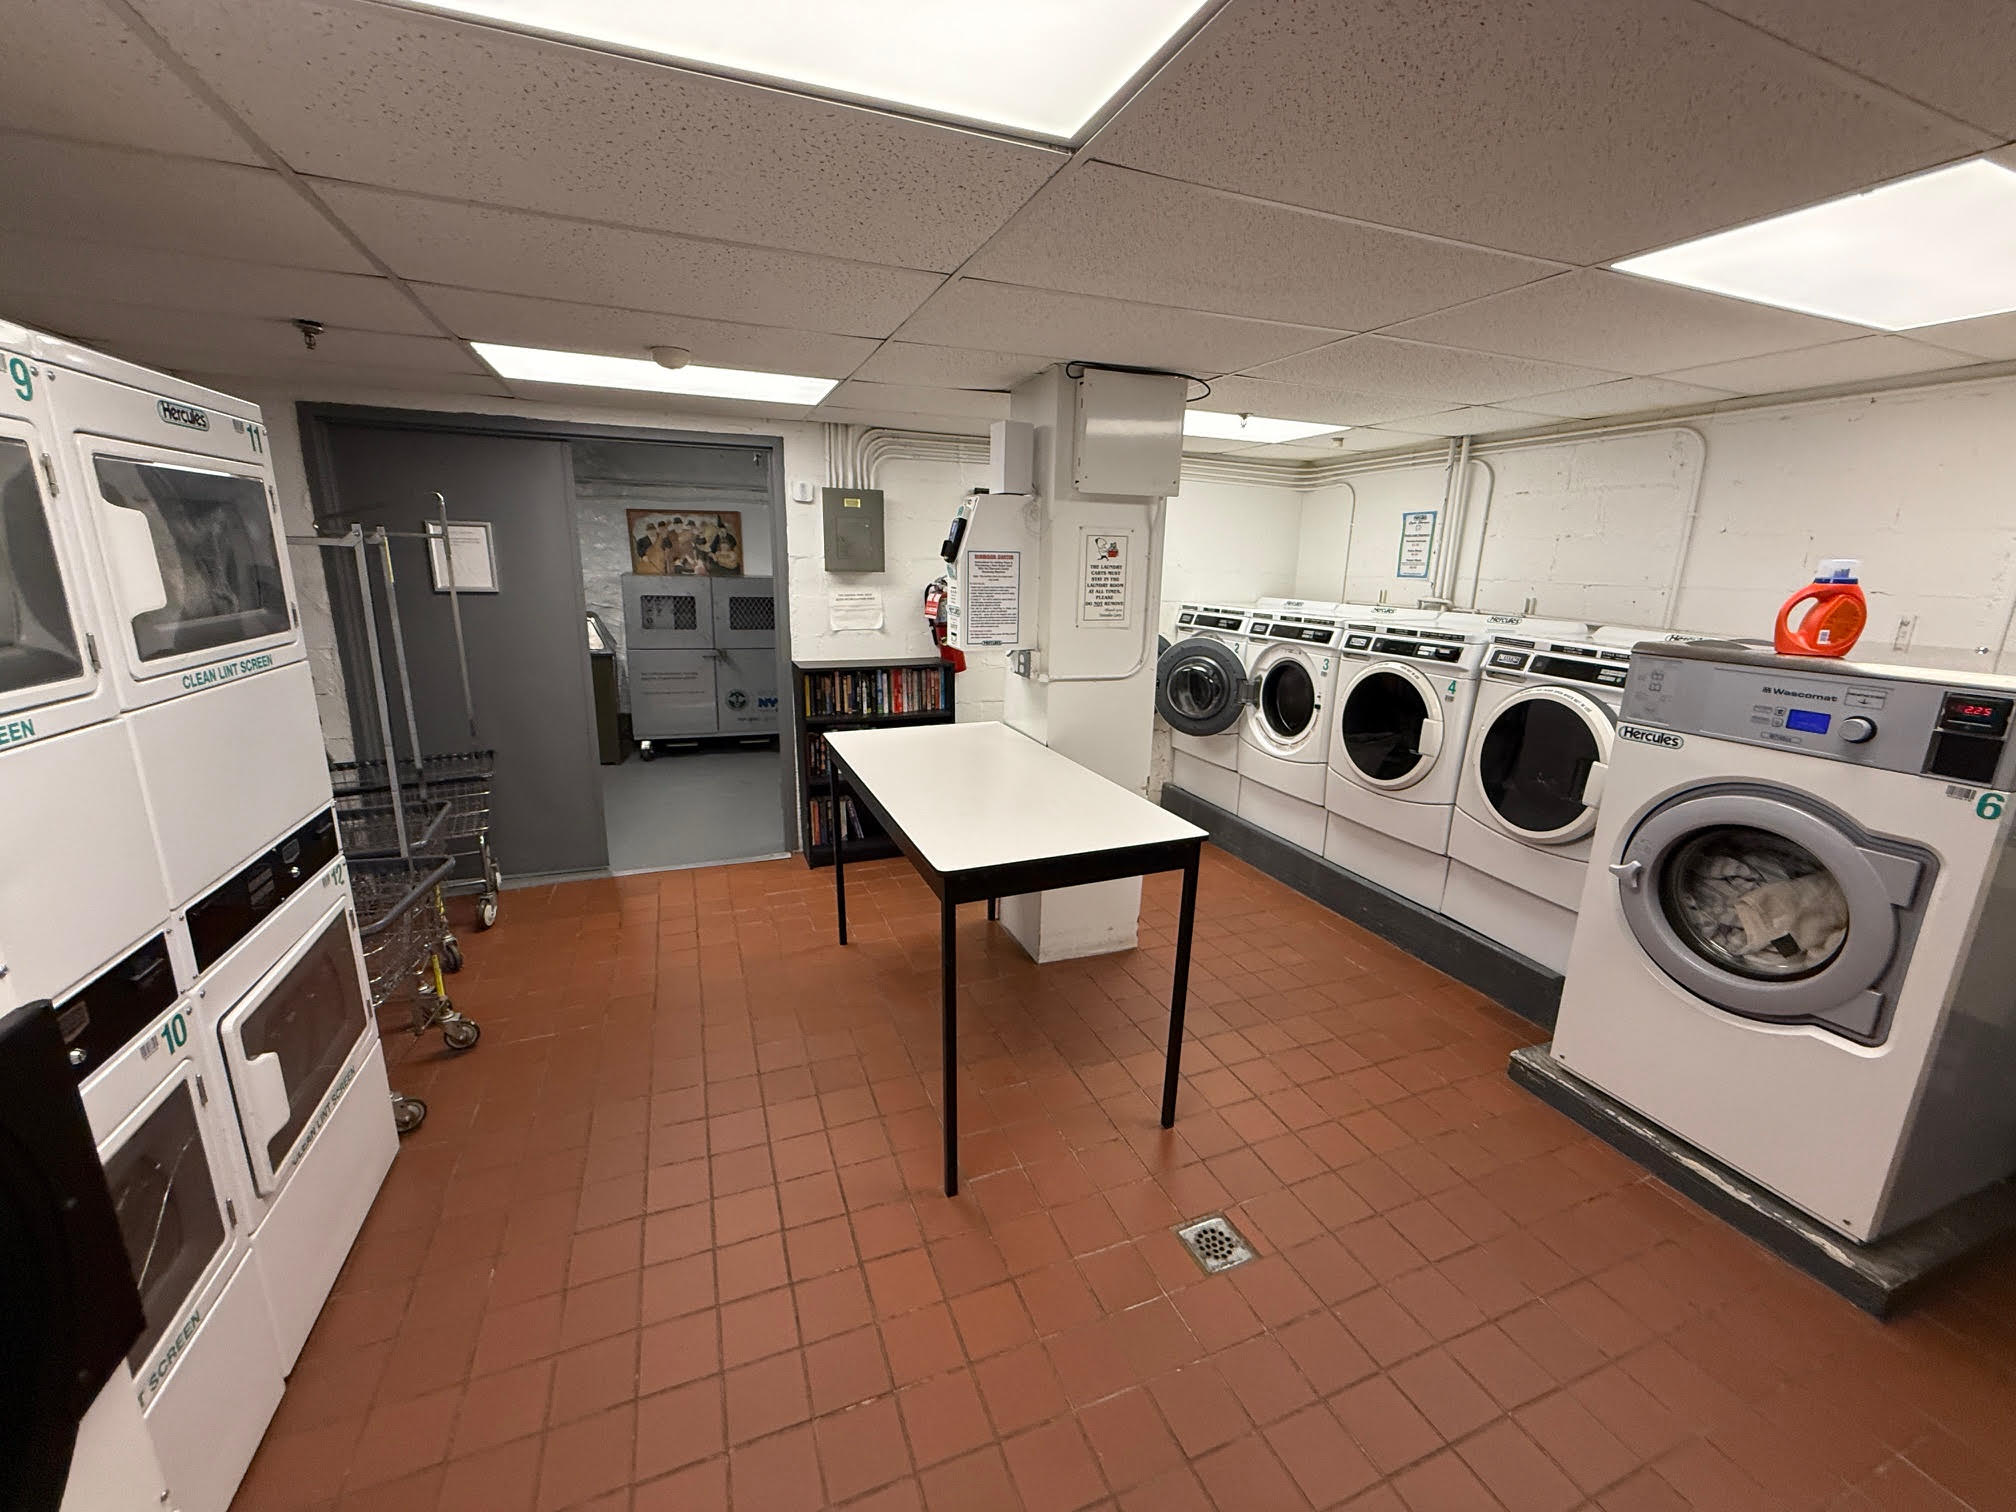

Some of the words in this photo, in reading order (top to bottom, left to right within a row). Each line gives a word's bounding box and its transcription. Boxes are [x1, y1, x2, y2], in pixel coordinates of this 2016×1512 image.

[10, 358, 33, 401] 9
[161, 401, 207, 428] Hercules
[247, 424, 263, 453] 11
[1234, 643, 1240, 653] 2
[182, 668, 217, 690] CLEAN
[217, 663, 238, 680] LINT
[239, 654, 273, 674] SCREEN
[1322, 658, 1330, 670] 3
[1447, 680, 1456, 694] 4
[1773, 688, 1838, 702] Wascomat
[1623, 726, 1680, 747] Hercules
[1976, 792, 2005, 820] 6
[331, 863, 345, 885] 12
[161, 1013, 187, 1056] 10
[331, 1065, 355, 1106] SCREEN
[149, 1309, 200, 1392] SCREEN
